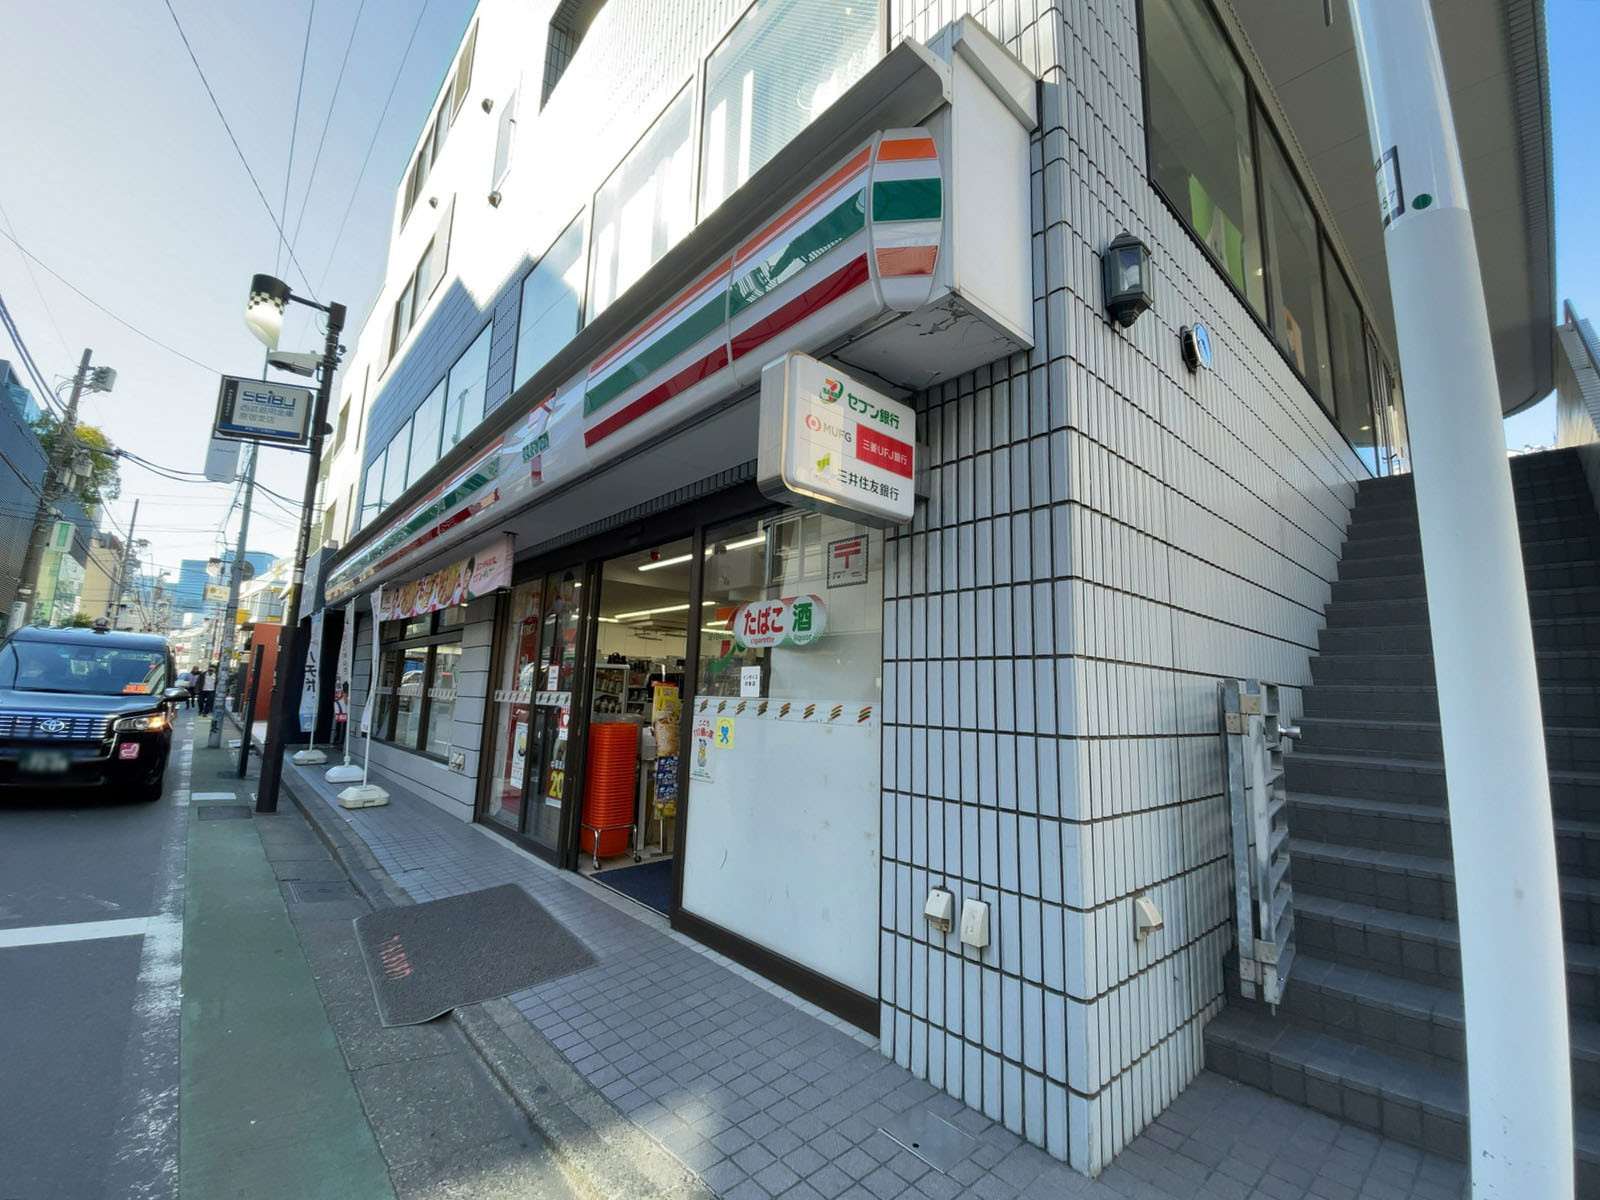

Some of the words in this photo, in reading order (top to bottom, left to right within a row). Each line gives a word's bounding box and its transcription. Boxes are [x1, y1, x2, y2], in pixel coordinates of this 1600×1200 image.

[847, 392, 900, 429] セブン銀行
[823, 422, 852, 443] MUFG
[863, 439, 908, 465] 三菱UFJ銀行
[838, 469, 899, 501] 三井住友銀行
[743, 606, 784, 635] たばこ
[792, 602, 813, 632] 酒
[750, 636, 776, 645] cigarette
[793, 633, 813, 643] liquor
